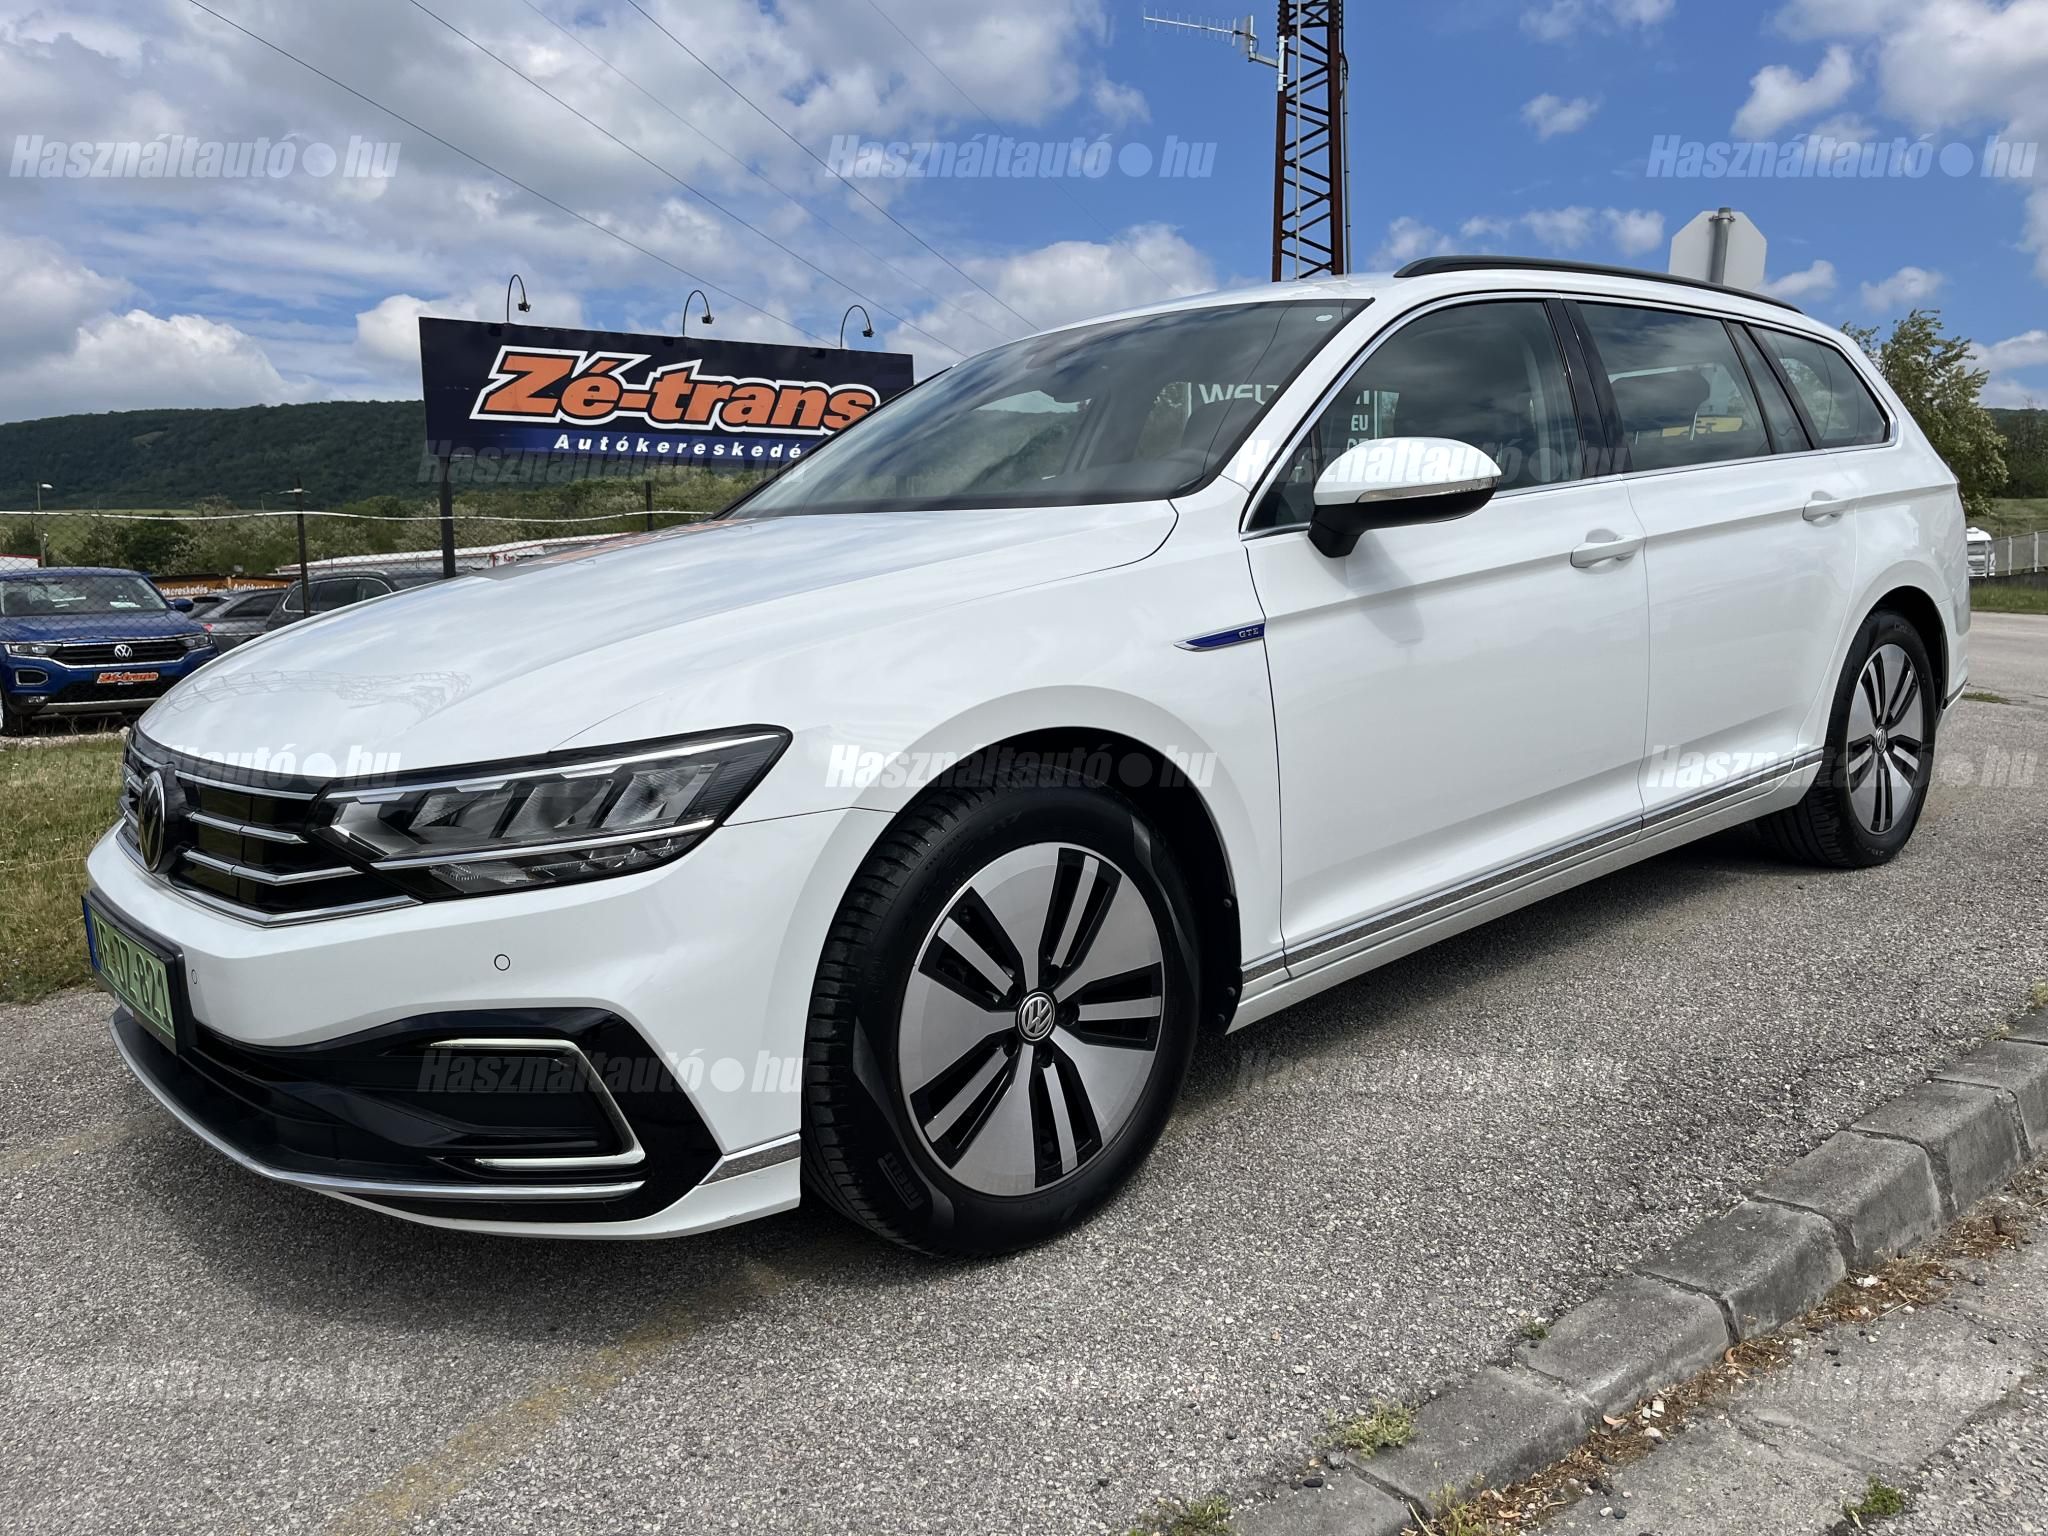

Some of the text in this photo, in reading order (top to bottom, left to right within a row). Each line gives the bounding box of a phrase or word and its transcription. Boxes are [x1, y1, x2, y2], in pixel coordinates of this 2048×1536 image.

[470, 346, 881, 436] Zé-trans
[1351, 414, 1369, 431] EU
[554, 433, 803, 459] Autókereskedé
[1239, 627, 1259, 639] GTE
